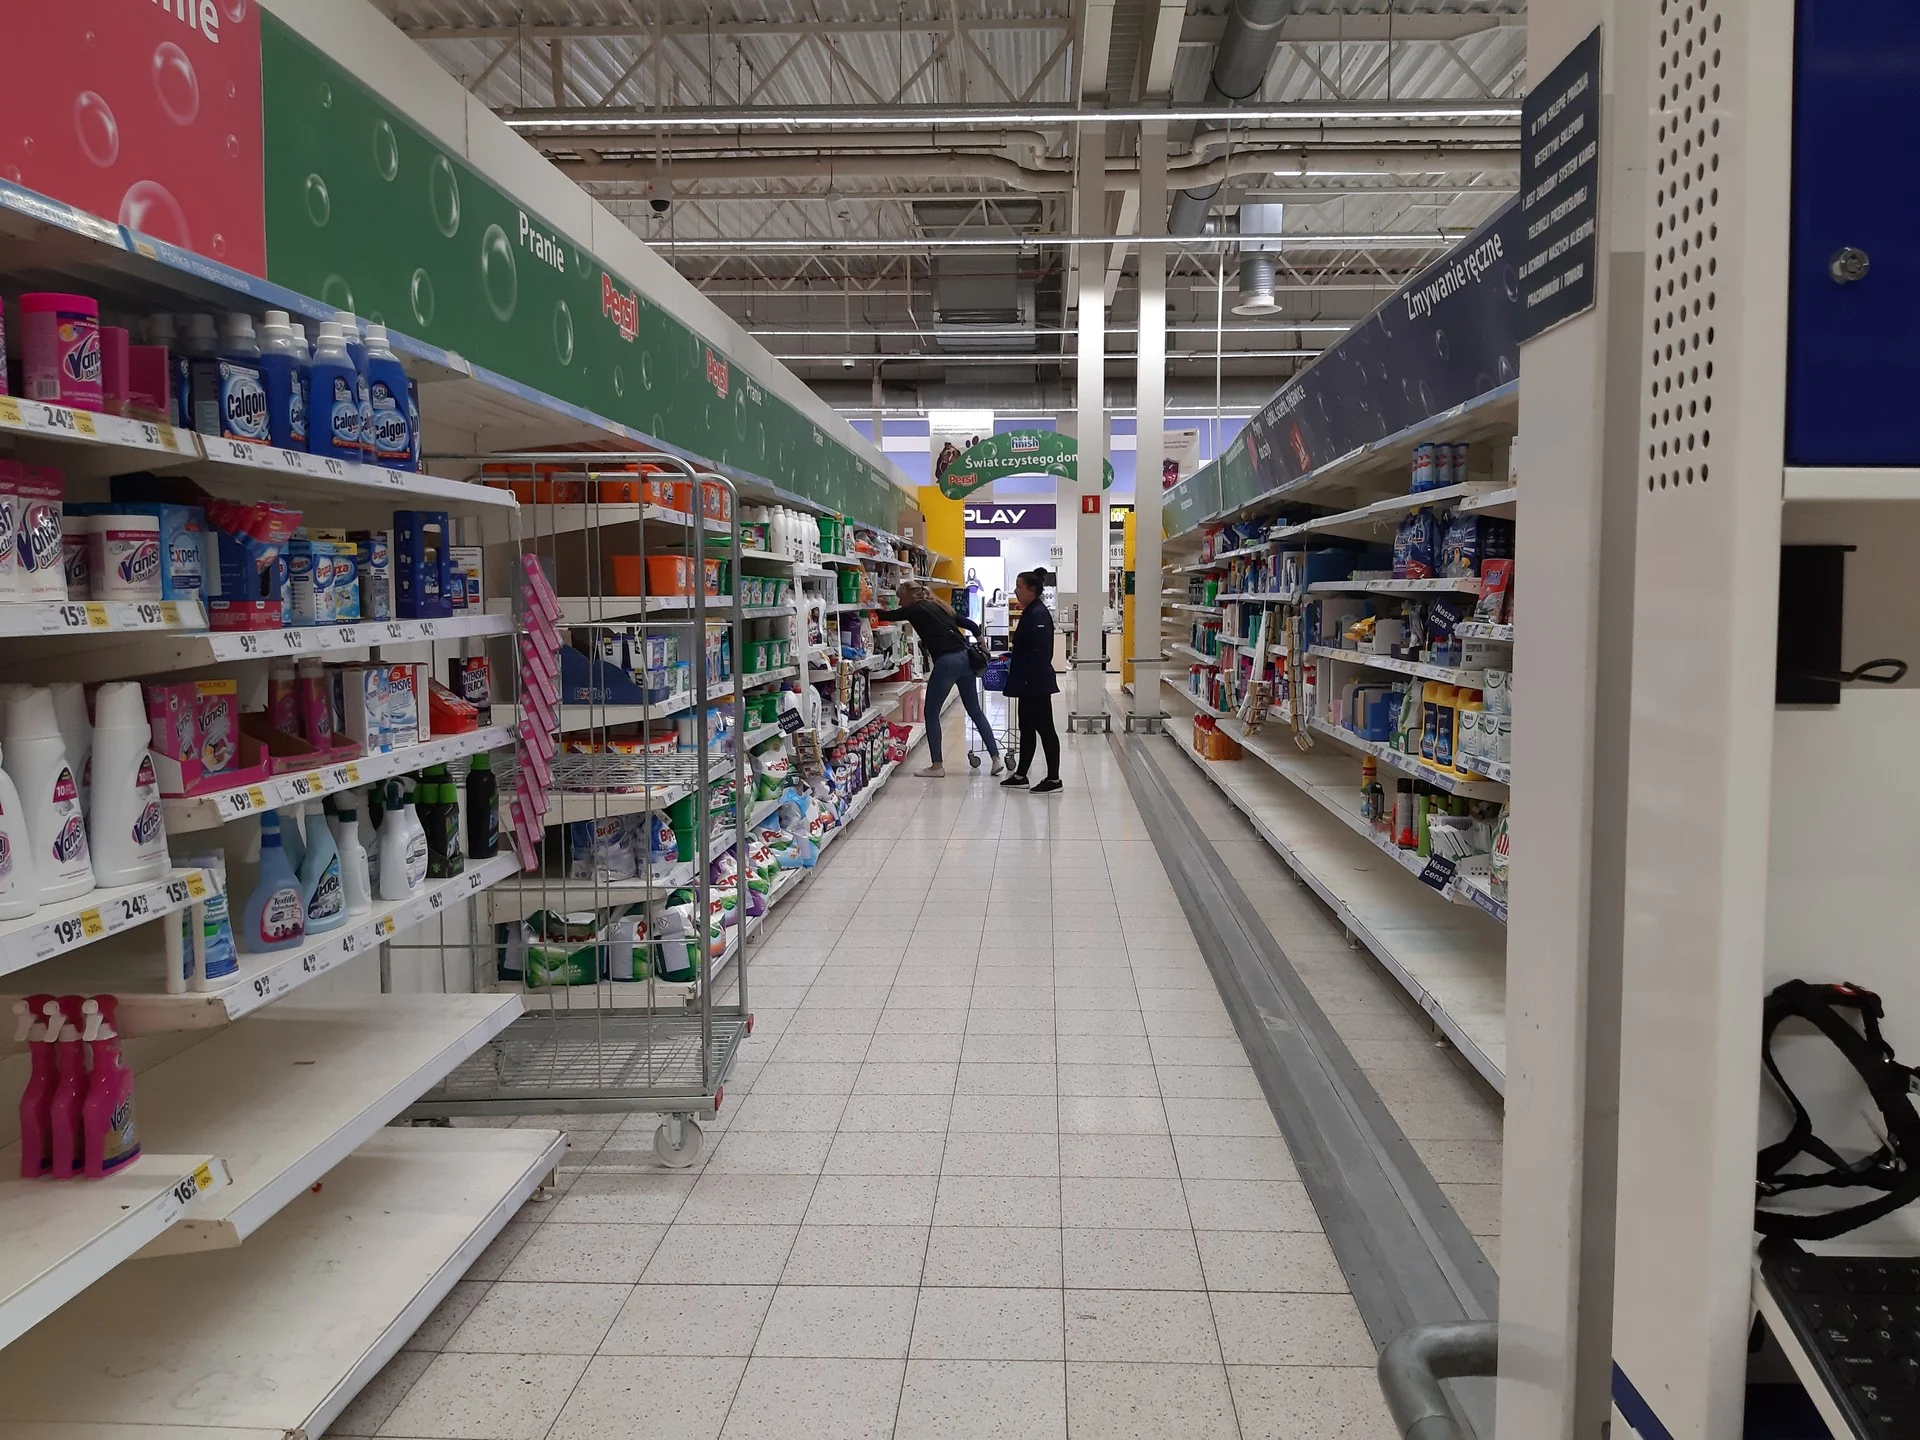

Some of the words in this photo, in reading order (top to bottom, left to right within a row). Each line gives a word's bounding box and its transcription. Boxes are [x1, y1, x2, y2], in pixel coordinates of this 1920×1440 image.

[1558, 156, 1578, 184] SYSTEM
[519, 210, 565, 273] Pranie
[1402, 259, 1467, 322] Zmywanie
[1465, 232, 1504, 284] ręczne
[601, 271, 640, 338] Persil
[706, 347, 729, 396] Persil
[227, 388, 265, 425] Calgon
[1011, 436, 1040, 450] finish
[965, 454, 999, 469] Świat
[1001, 455, 1055, 468] czystego
[948, 473, 978, 485] Persil
[17, 500, 62, 573] Vanish
[168, 543, 201, 566] Expert
[1430, 614, 1448, 629] cena
[1435, 603, 1455, 622] Nasza
[463, 667, 488, 685] INTENSIVE
[467, 678, 484, 692] BLACK
[198, 700, 228, 732] Vanish
[780, 711, 799, 724] Nasza
[784, 719, 800, 730] cena
[596, 819, 621, 838] Bryza
[1424, 869, 1444, 883] cena
[1430, 858, 1451, 877] Nasza
[273, 894, 297, 906] Textile
